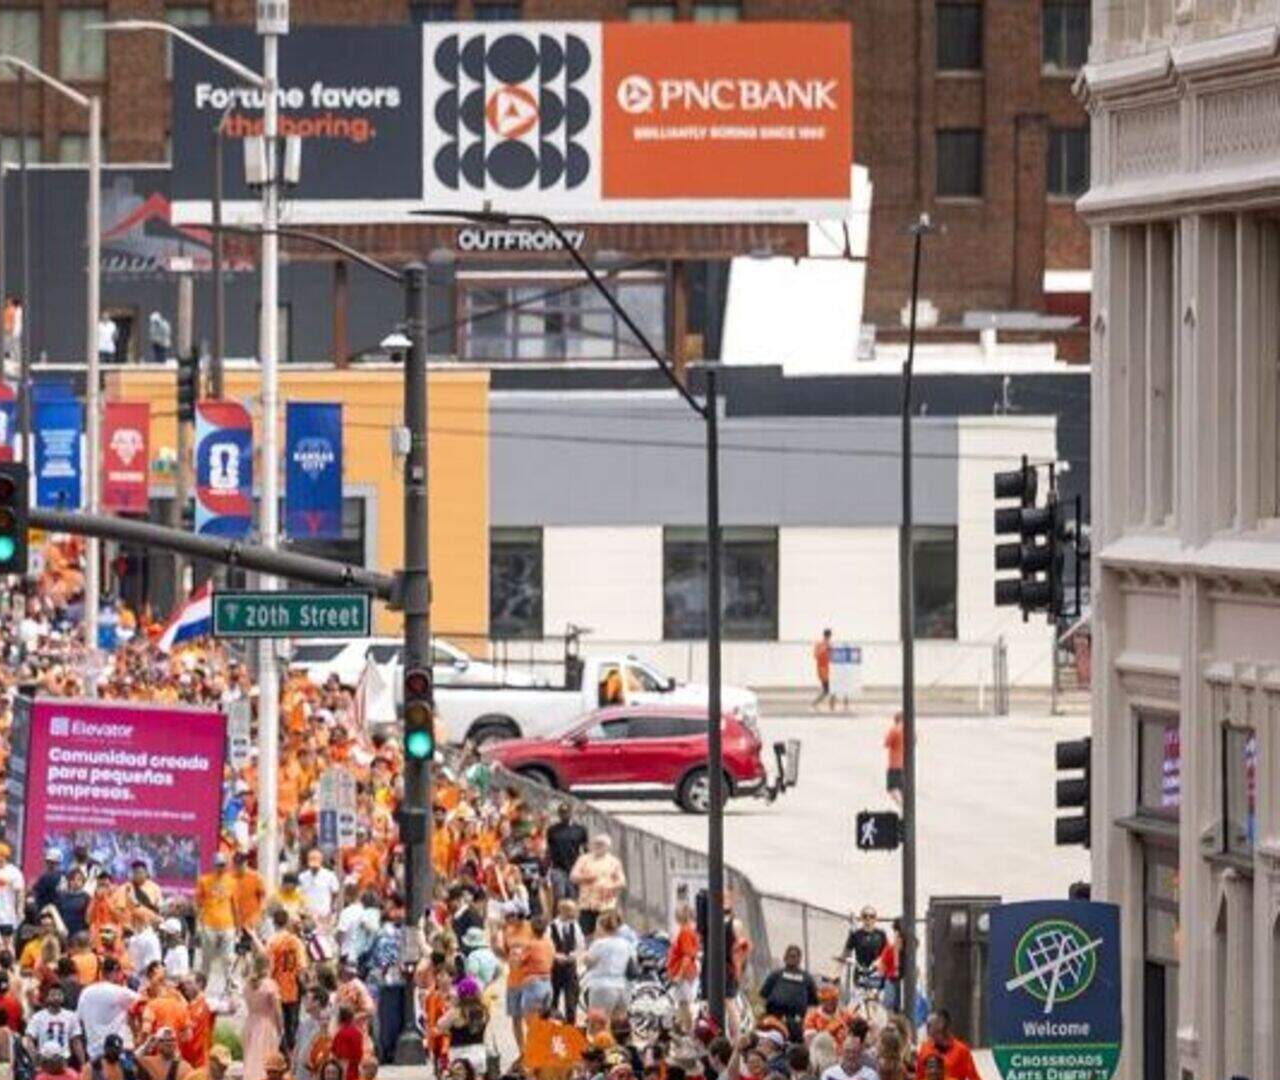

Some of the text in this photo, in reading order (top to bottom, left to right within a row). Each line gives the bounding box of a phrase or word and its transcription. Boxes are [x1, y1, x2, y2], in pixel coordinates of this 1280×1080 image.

[310, 81, 400, 109] favors
[660, 78, 838, 111] PNC BANK
[245, 603, 359, 627] 20th Street
[48, 747, 148, 768] Comunidad
[48, 766, 174, 786] para pequeñas
[47, 783, 136, 800] empresas.
[1022, 1021, 1091, 1037] Welcome
[1010, 1054, 1104, 1068] CROSSROADS
